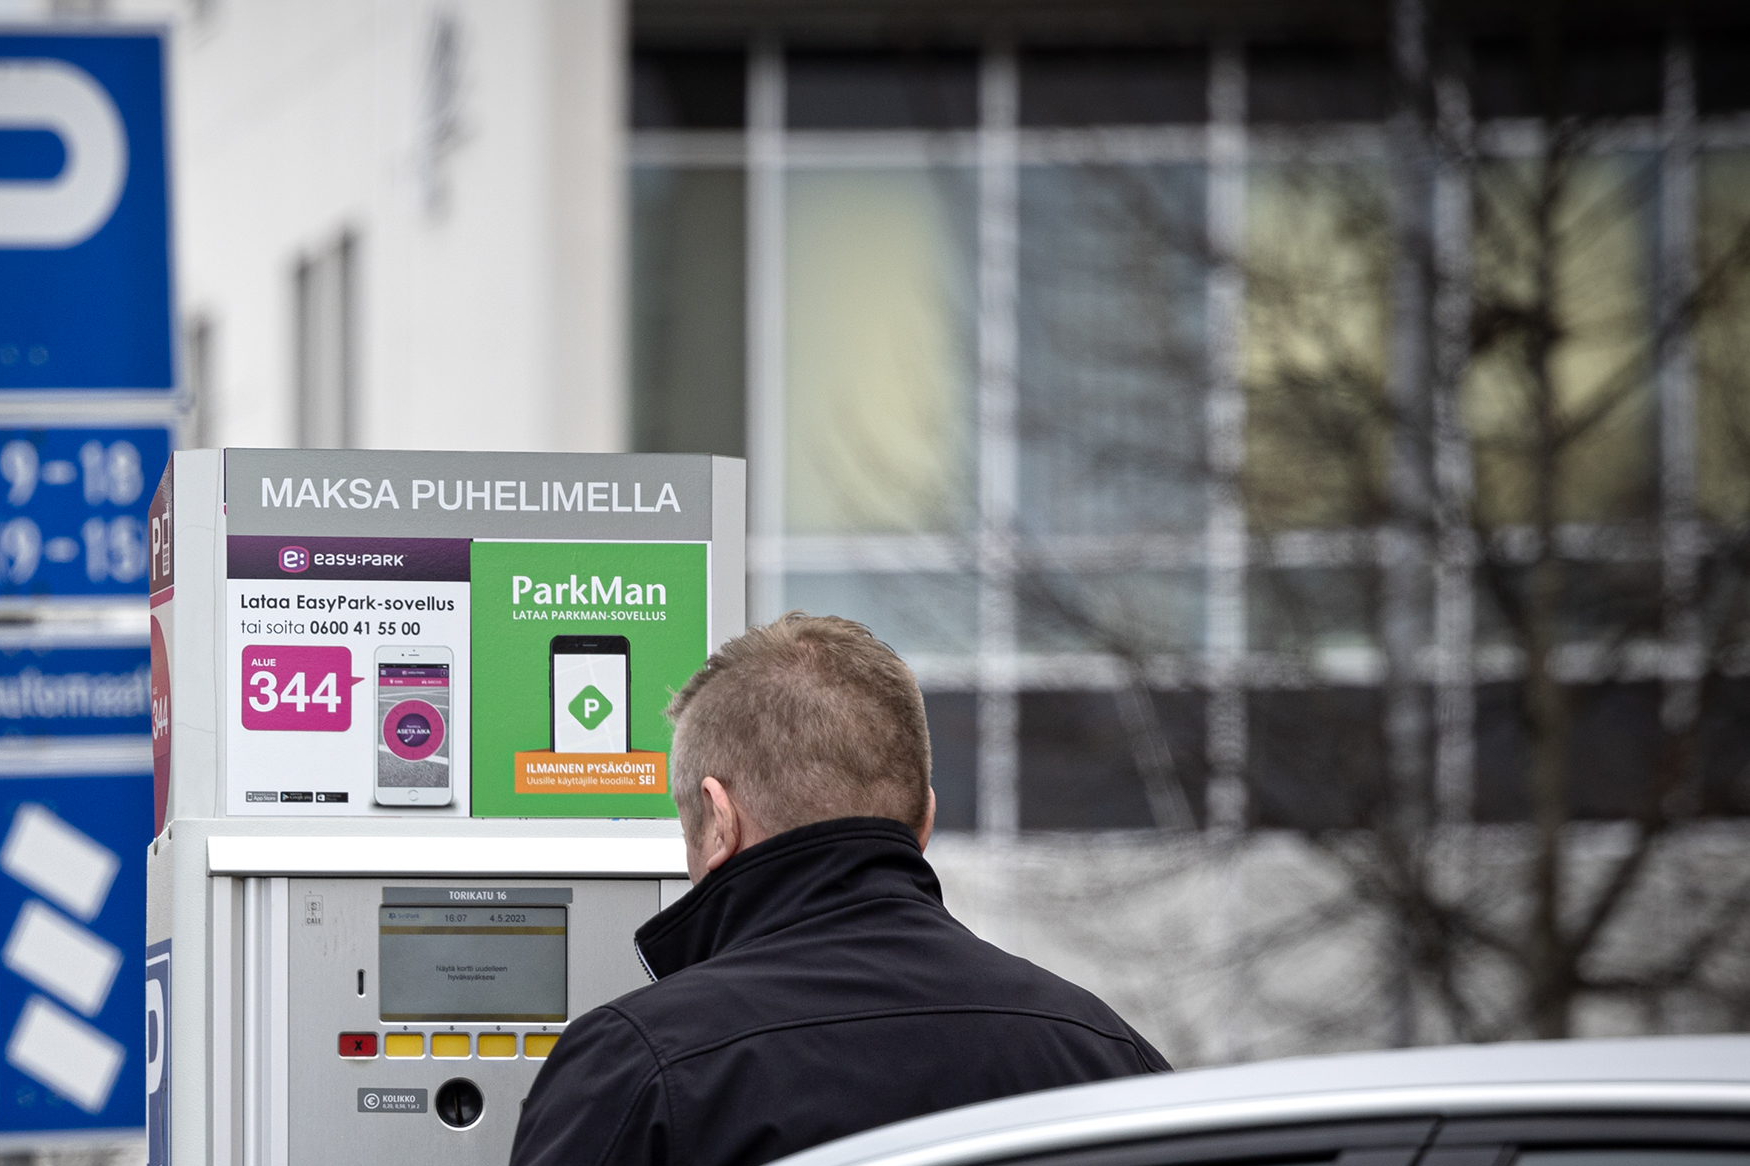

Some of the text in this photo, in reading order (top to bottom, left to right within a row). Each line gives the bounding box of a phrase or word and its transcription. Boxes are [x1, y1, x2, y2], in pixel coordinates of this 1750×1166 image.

[0, 440, 145, 507] 9-18
[262, 477, 681, 513] MAKSA PUHELIMELLA
[512, 574, 667, 605] ParkMan
[240, 594, 455, 613] Lataa EasyPark-sovellus
[512, 610, 667, 621] LATAA PARKMAN-SOVELLUS
[240, 619, 421, 635] tai soita 0600 41 55 00
[251, 658, 277, 667] ALUE
[248, 670, 342, 713] 344
[584, 698, 600, 719] P
[152, 694, 168, 740] 344
[526, 761, 655, 774] ILMAINEN PYSÄKÖINTI
[526, 775, 656, 787] Uusille käyttäjille koodilla: SEI
[449, 890, 507, 900] TORIKATU 16
[444, 914, 467, 922] 16:07
[489, 914, 526, 923] 4.5.2023
[382, 1094, 416, 1103] KOLIKKO
